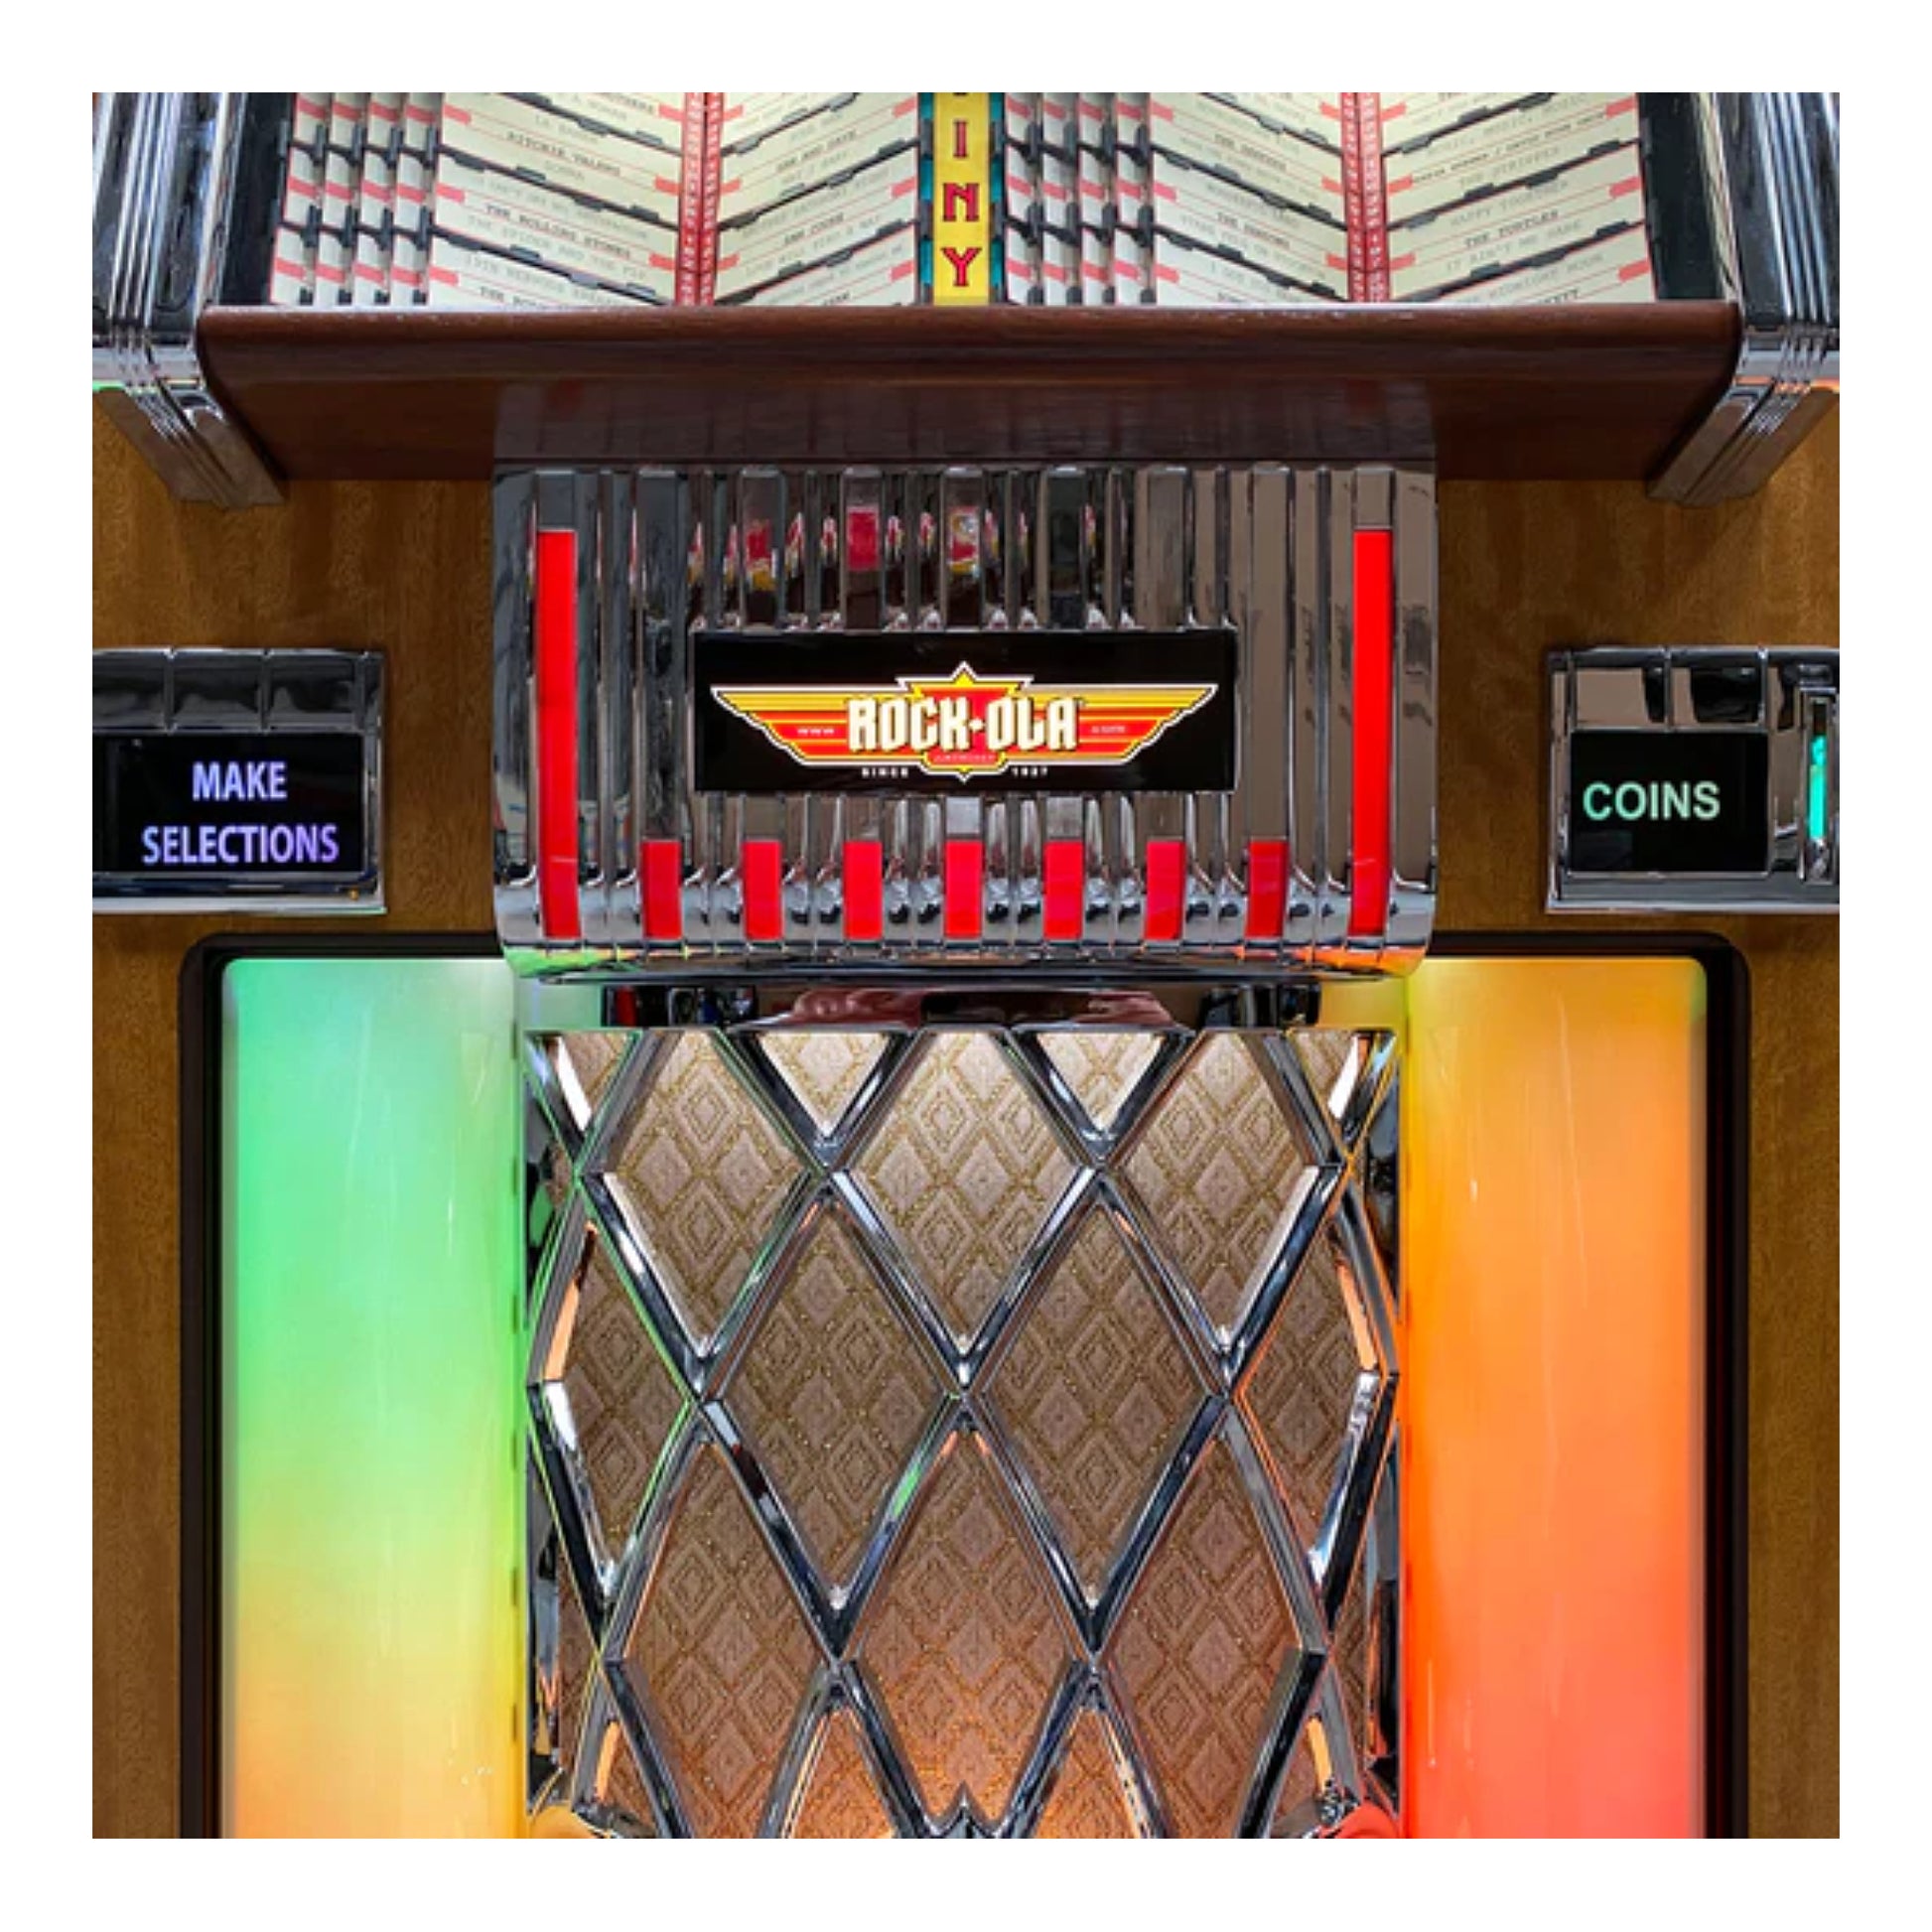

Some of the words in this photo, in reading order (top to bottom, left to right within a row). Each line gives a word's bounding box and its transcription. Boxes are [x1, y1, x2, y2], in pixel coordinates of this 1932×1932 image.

[192, 760, 288, 801] MAKE
[1583, 780, 1721, 821] COINS
[141, 823, 340, 865] SELECTIONS
